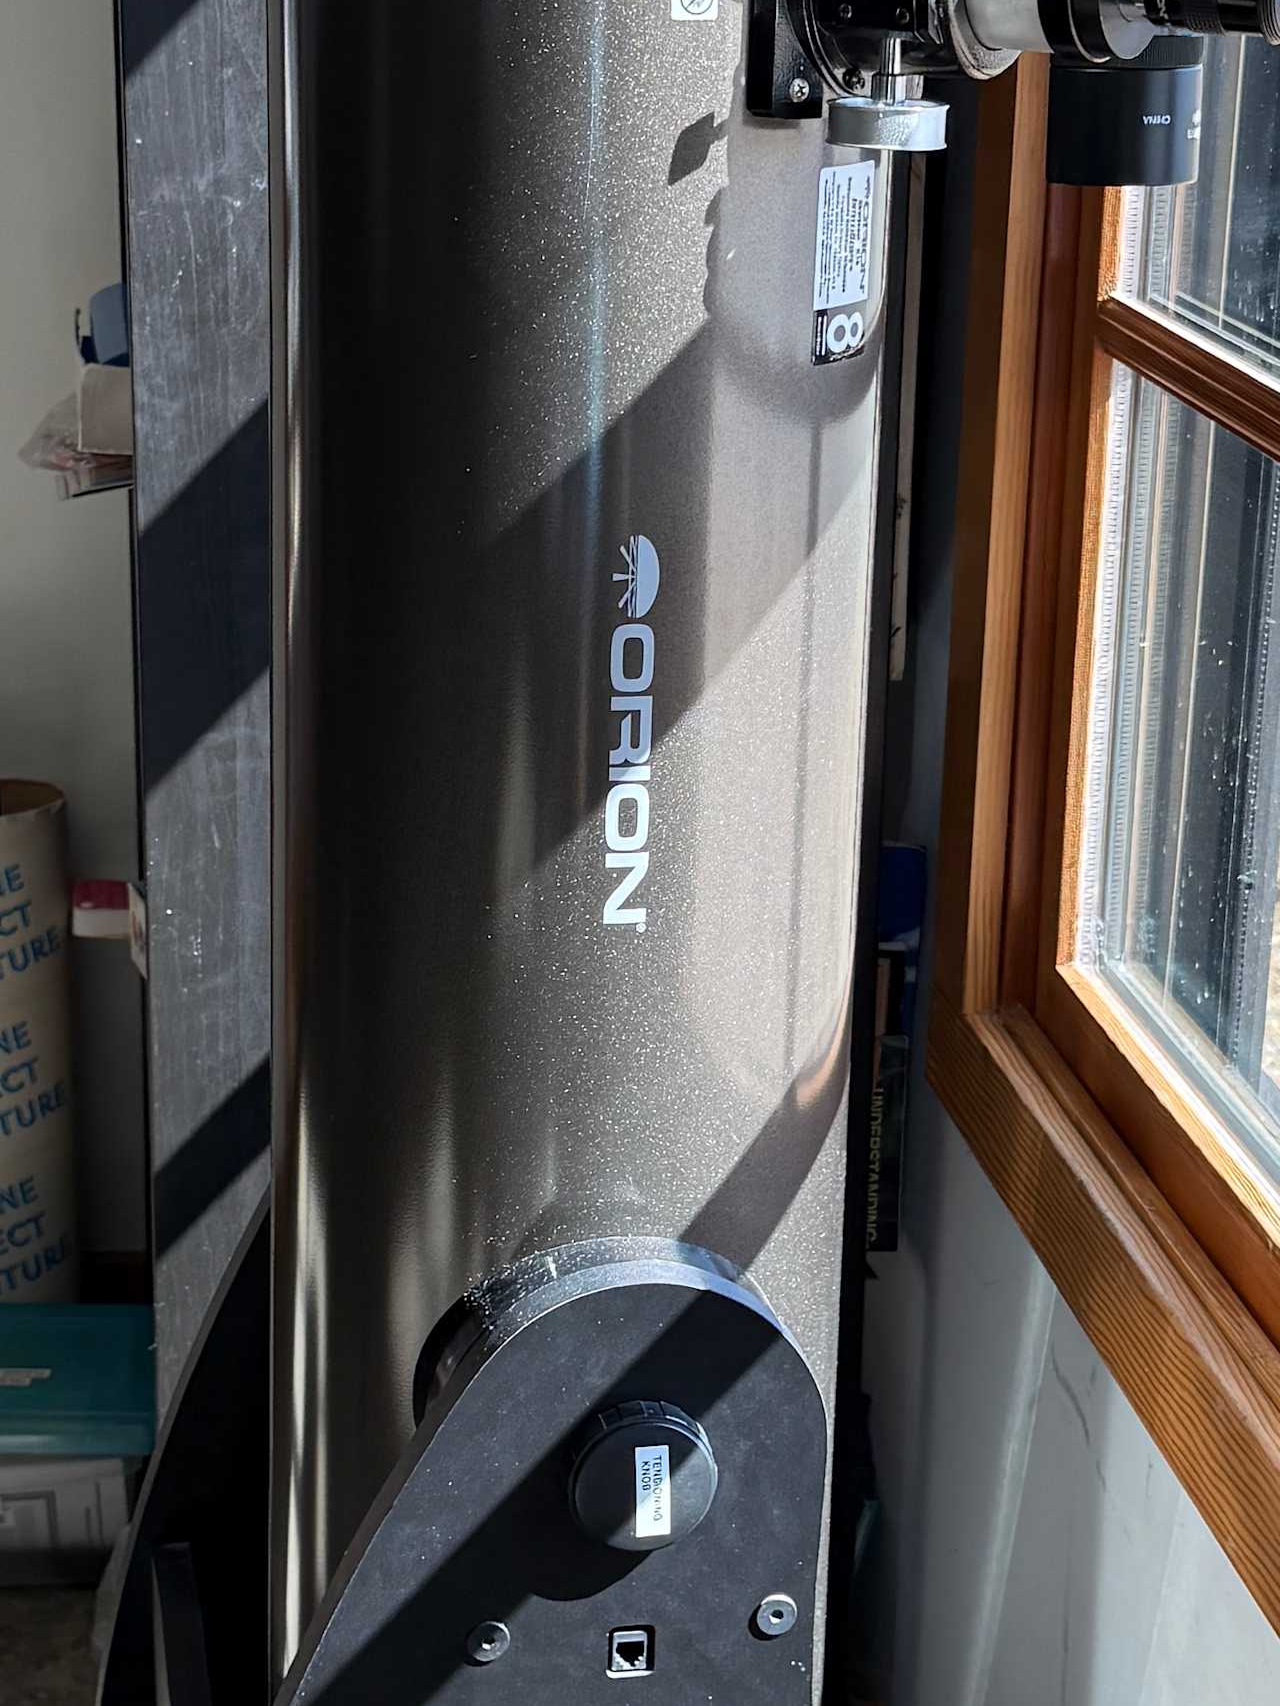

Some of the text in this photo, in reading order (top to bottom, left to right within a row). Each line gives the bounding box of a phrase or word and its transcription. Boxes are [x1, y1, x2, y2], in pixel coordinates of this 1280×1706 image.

[827, 311, 864, 353] 8
[602, 623, 655, 926] ORION
[641, 1461, 652, 1492] KNOB
